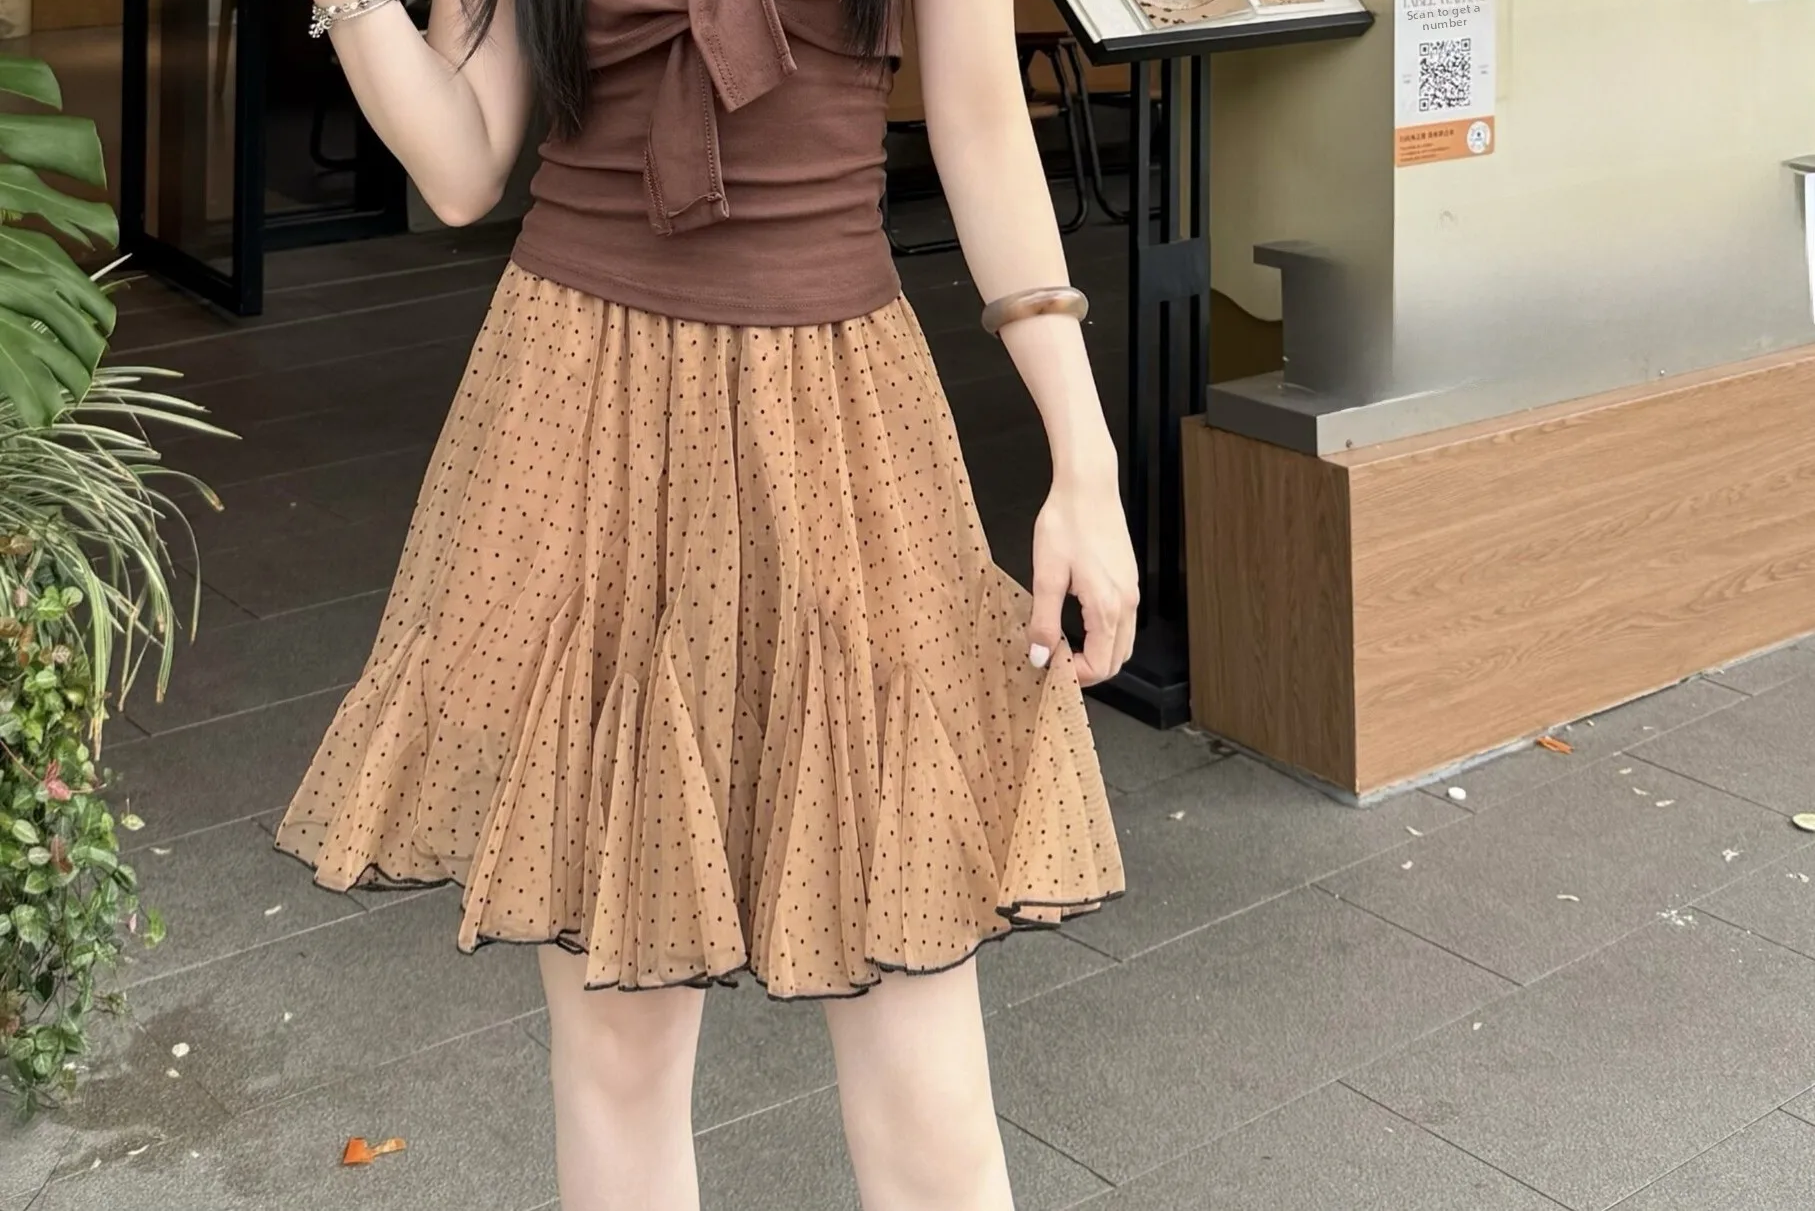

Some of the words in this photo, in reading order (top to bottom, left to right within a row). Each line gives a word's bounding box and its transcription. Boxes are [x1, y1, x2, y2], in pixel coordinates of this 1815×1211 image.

[1407, 10, 1434, 21] Scan
[1437, 8, 1449, 17] to
[1451, 4, 1471, 18] get
[1473, 5, 1481, 13] a
[1422, 18, 1468, 31] number
